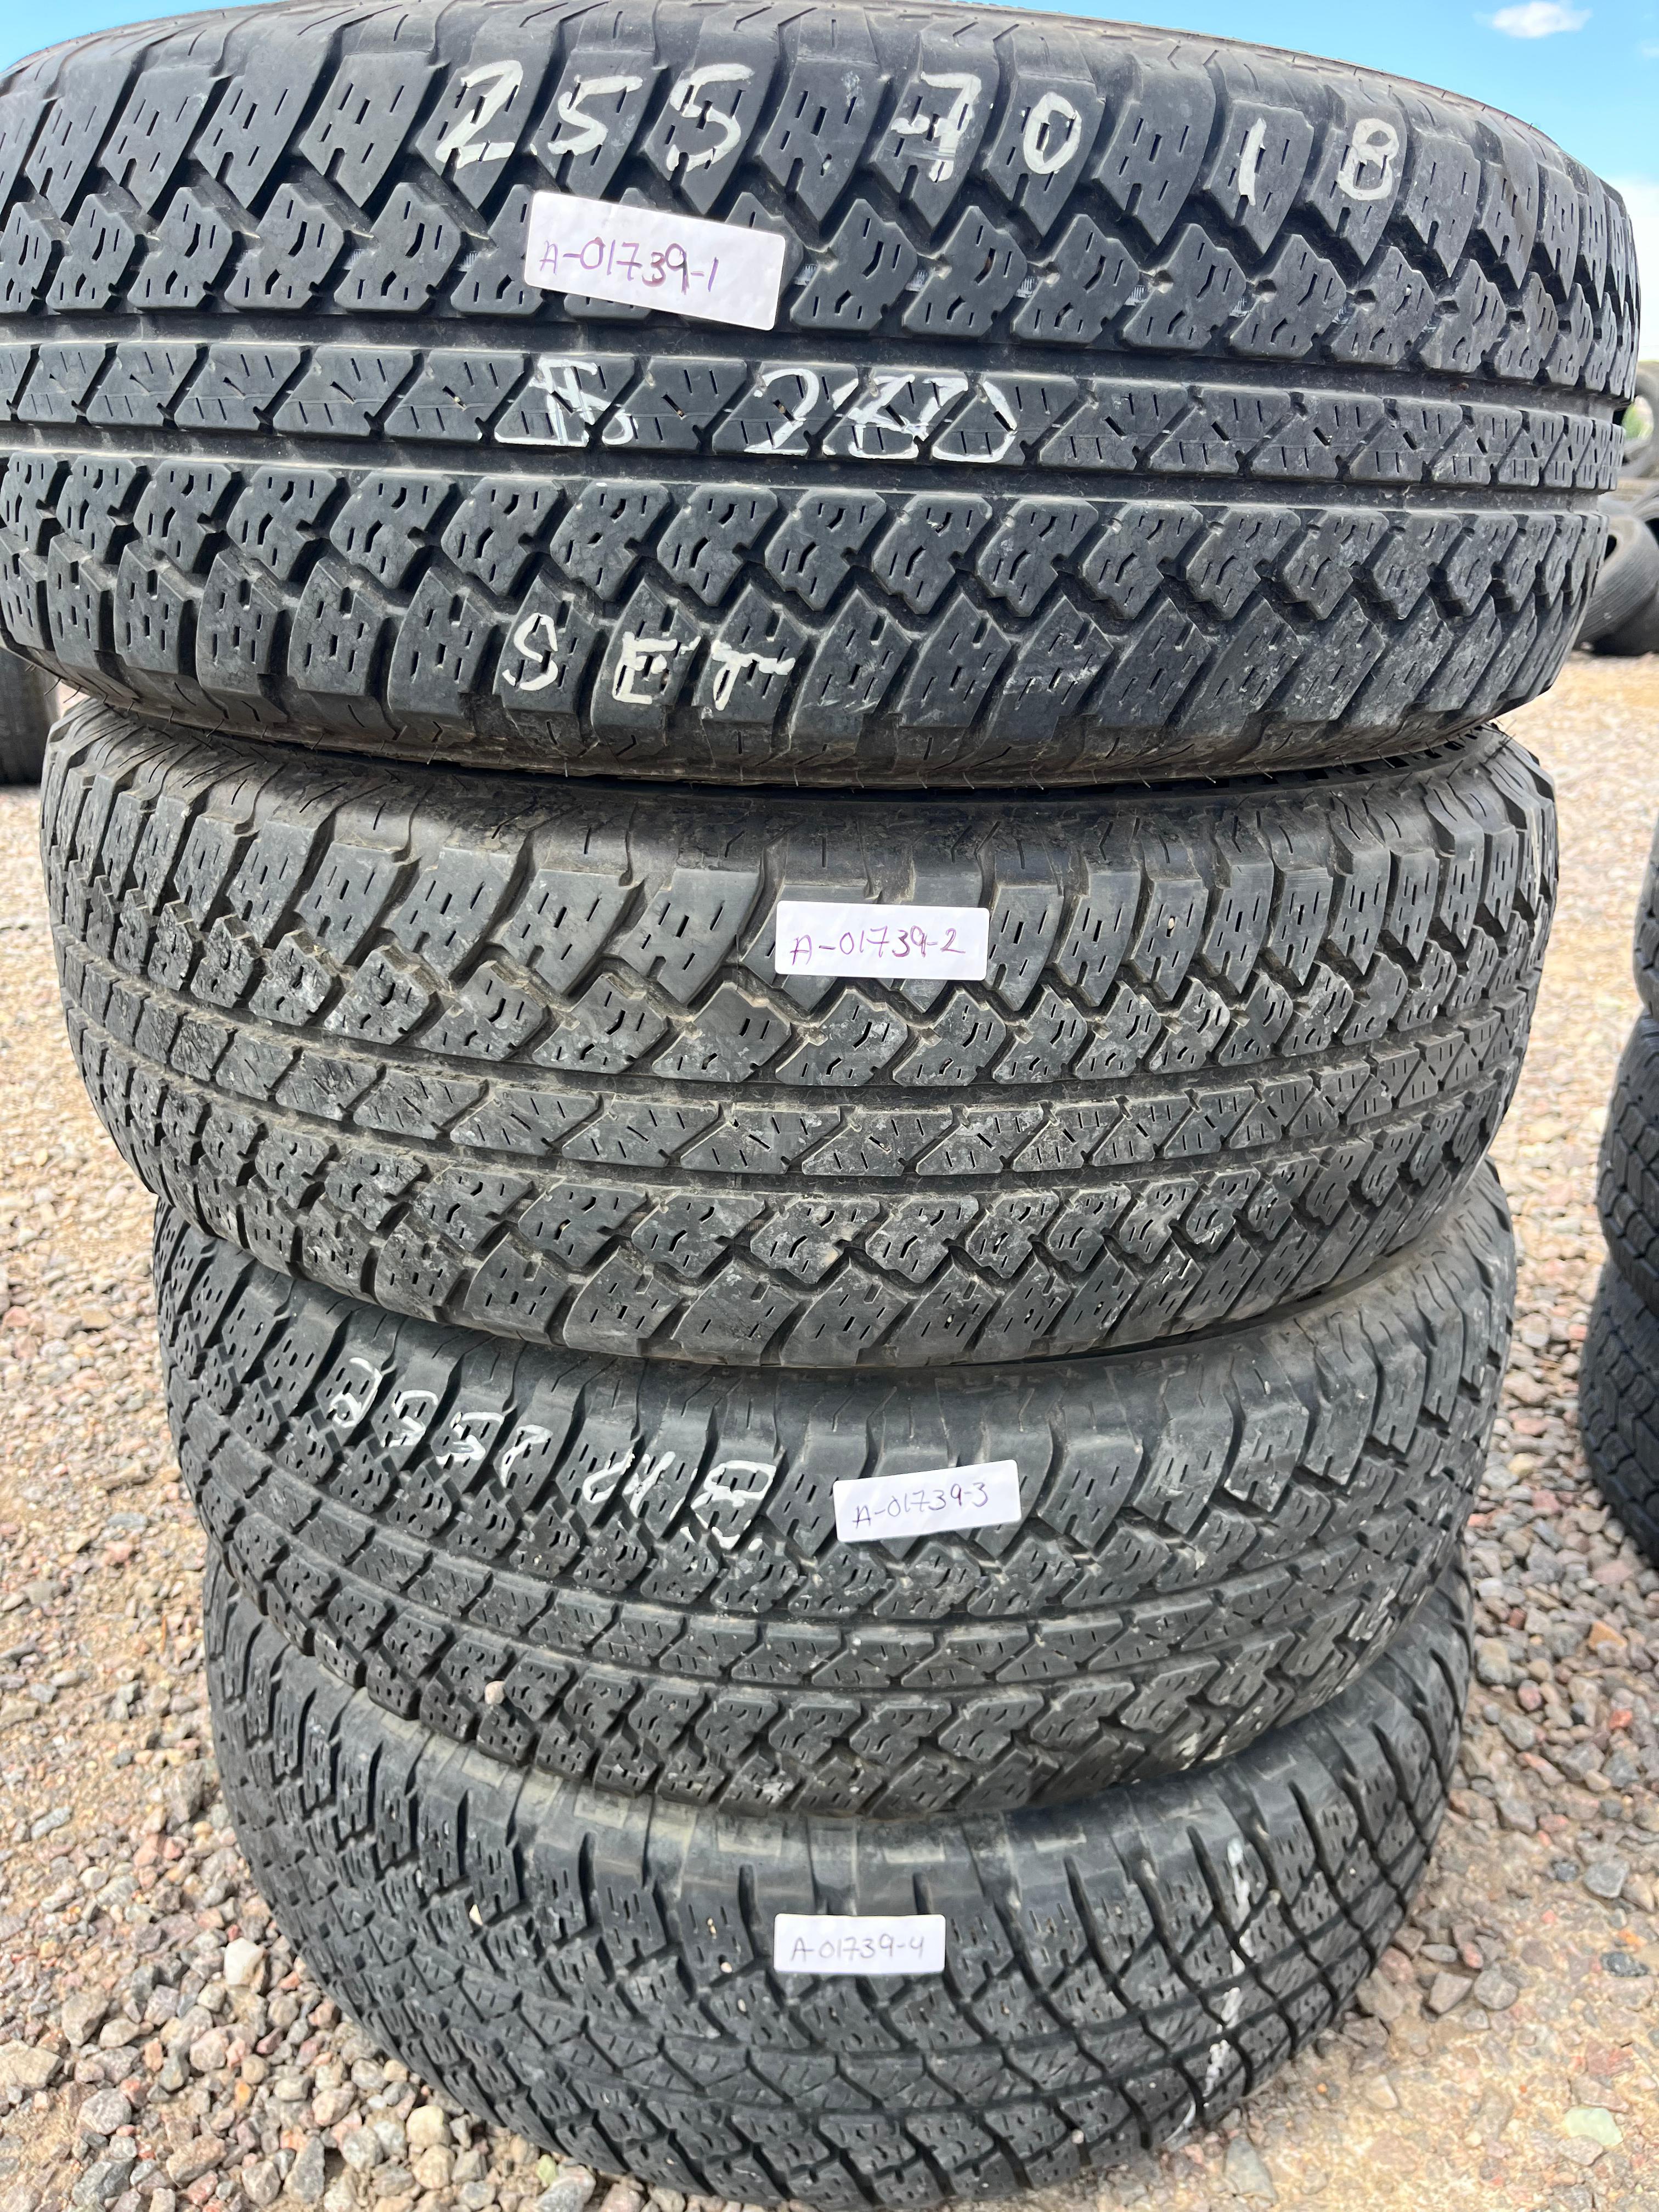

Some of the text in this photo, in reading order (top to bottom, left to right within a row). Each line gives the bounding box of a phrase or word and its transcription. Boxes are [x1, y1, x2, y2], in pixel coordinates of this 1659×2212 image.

[436, 60, 1398, 206] 255 70 18
[539, 237, 719, 295] A-01739-1
[503, 613, 795, 711] SET
[789, 925, 966, 966] A-01739-2
[852, 1481, 988, 1528] A-01739-3
[791, 1933, 924, 1962] A-01739-4
